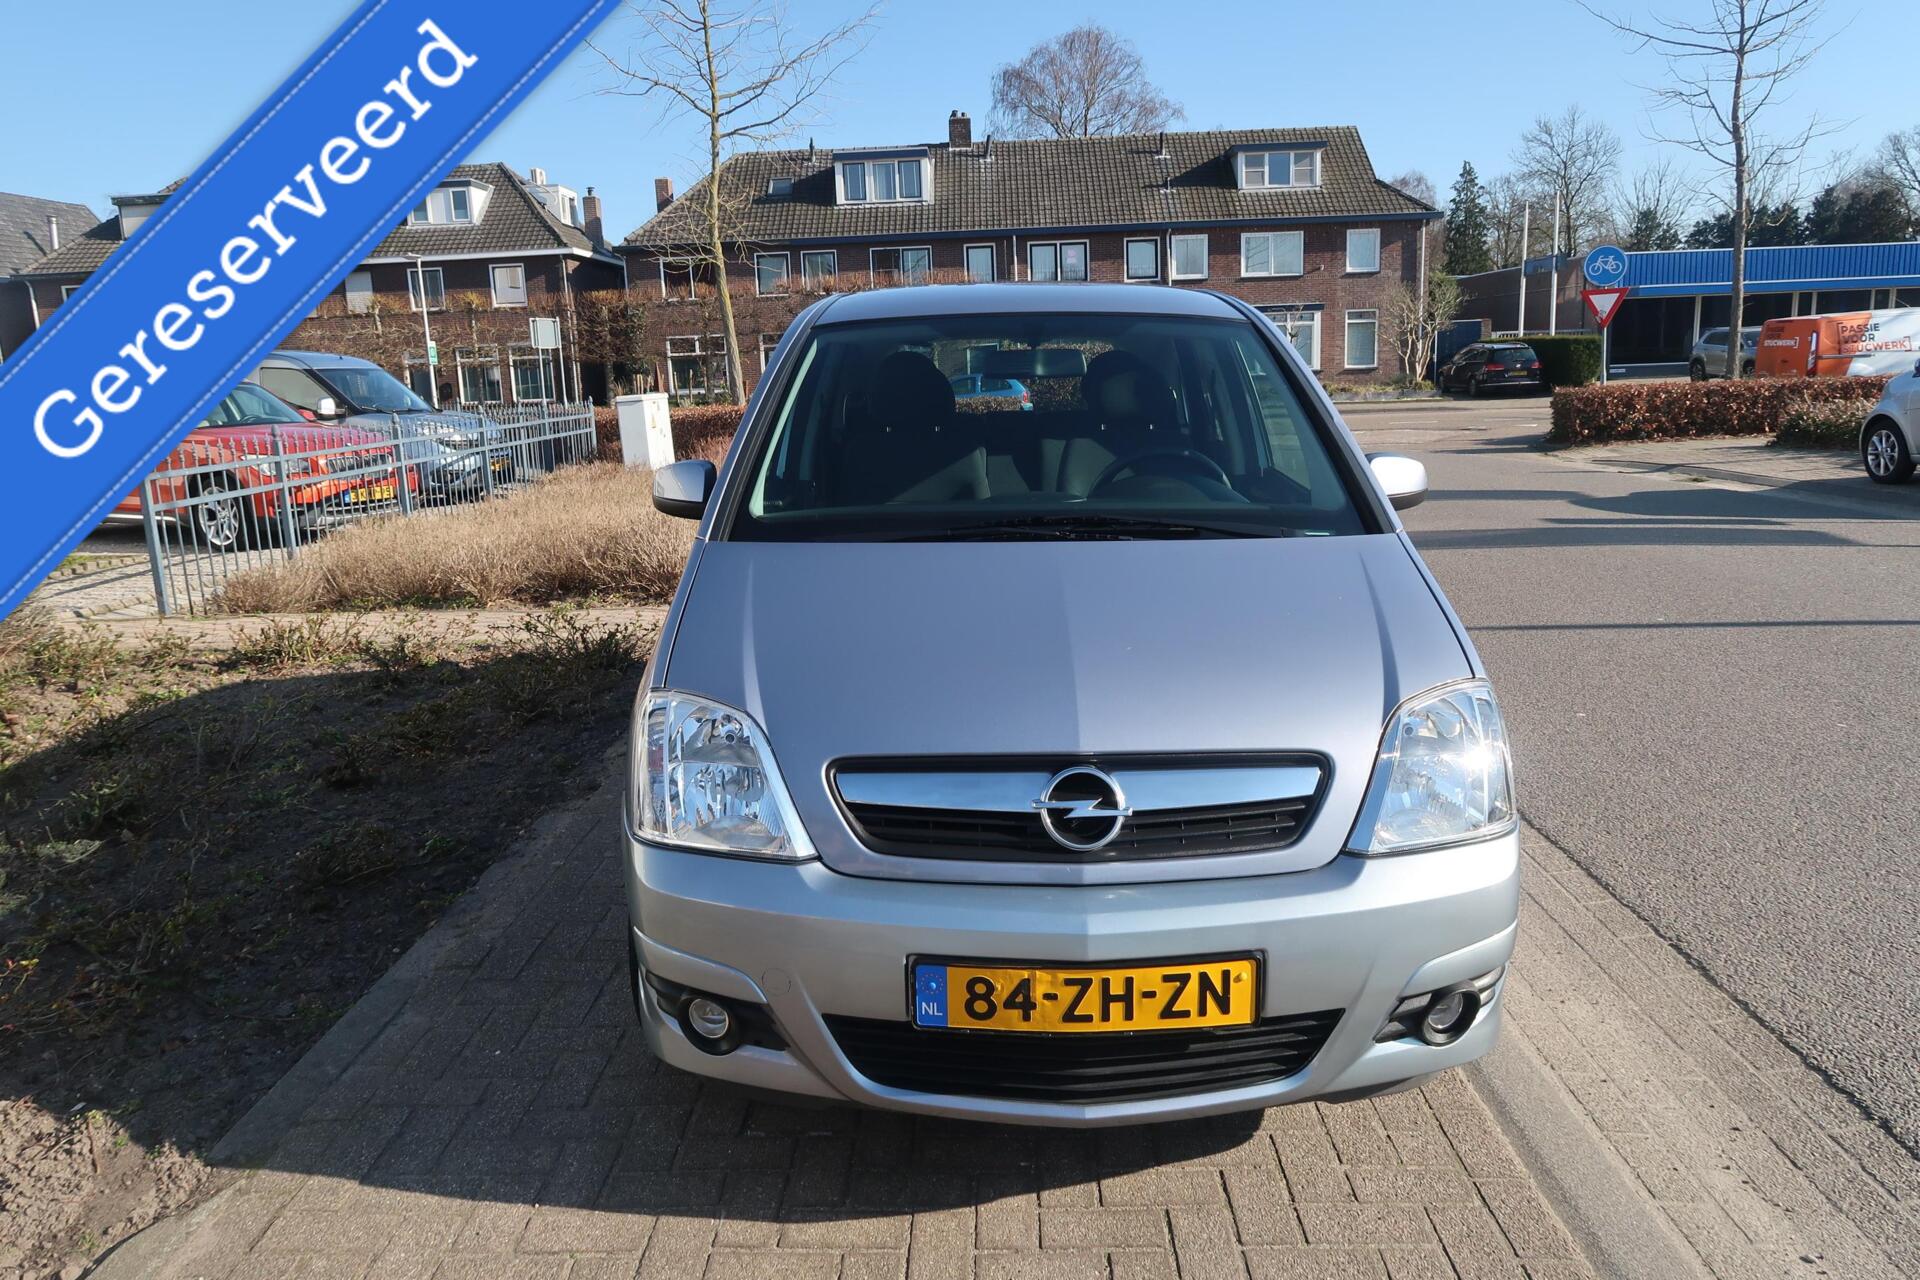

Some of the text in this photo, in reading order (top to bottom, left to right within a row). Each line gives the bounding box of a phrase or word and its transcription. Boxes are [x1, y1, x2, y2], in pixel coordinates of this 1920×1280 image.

[1841, 323, 1880, 334] PASSIE
[1842, 333, 1876, 344] VOOR
[1841, 339, 1907, 354] STUCWERK
[963, 969, 1231, 1024] 84-ZH-ZN
[921, 1001, 943, 1016] NL
